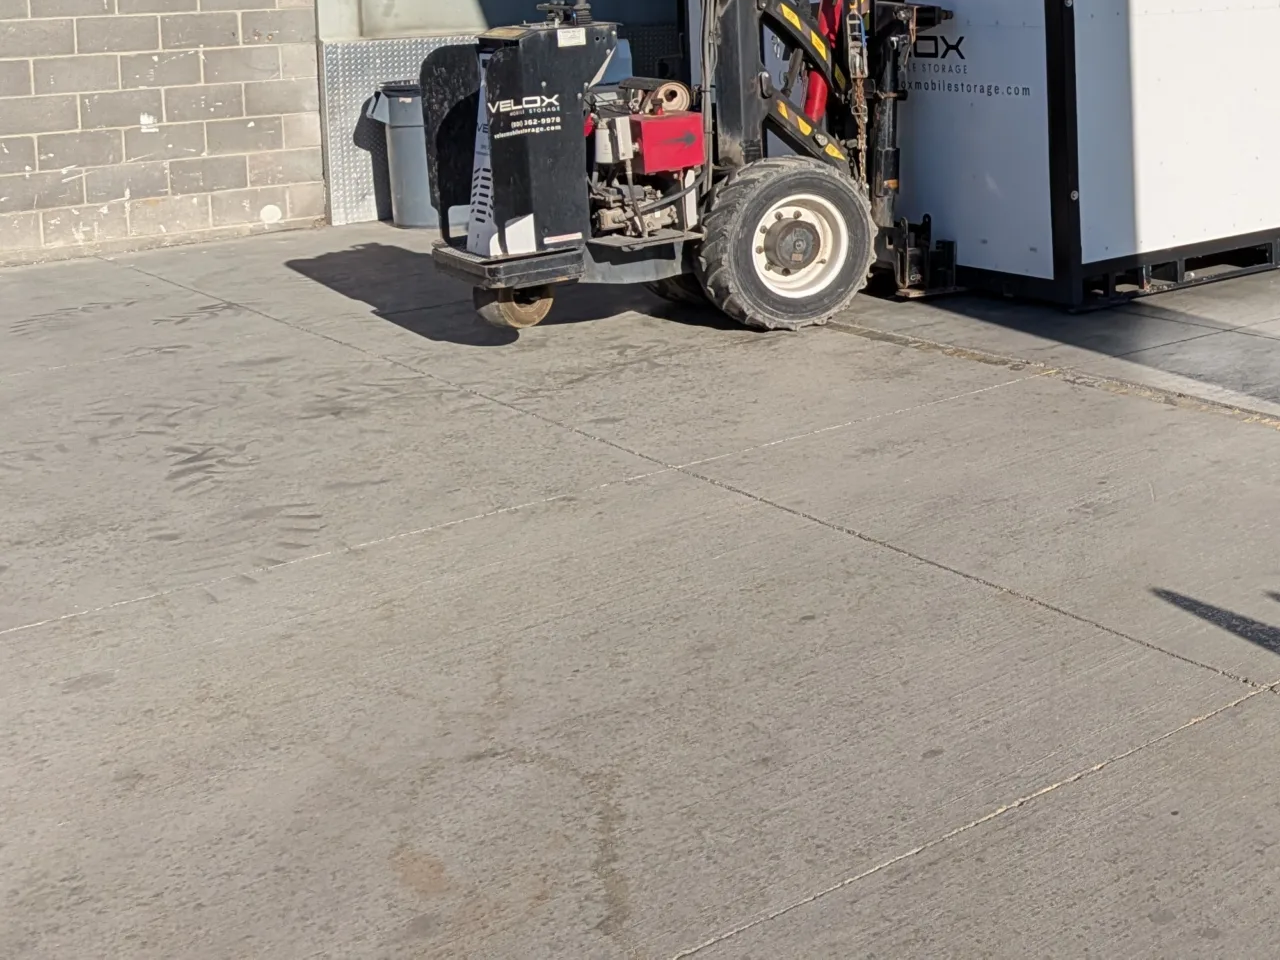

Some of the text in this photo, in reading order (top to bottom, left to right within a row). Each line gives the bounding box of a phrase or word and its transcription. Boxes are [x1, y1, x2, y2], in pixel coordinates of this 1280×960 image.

[921, 63, 968, 75] STORAGE
[900, 79, 1031, 97] oxmobilestorage.com
[487, 93, 560, 114] VELOX
[528, 106, 561, 114] STORAGE
[524, 116, 561, 127] 362-9978
